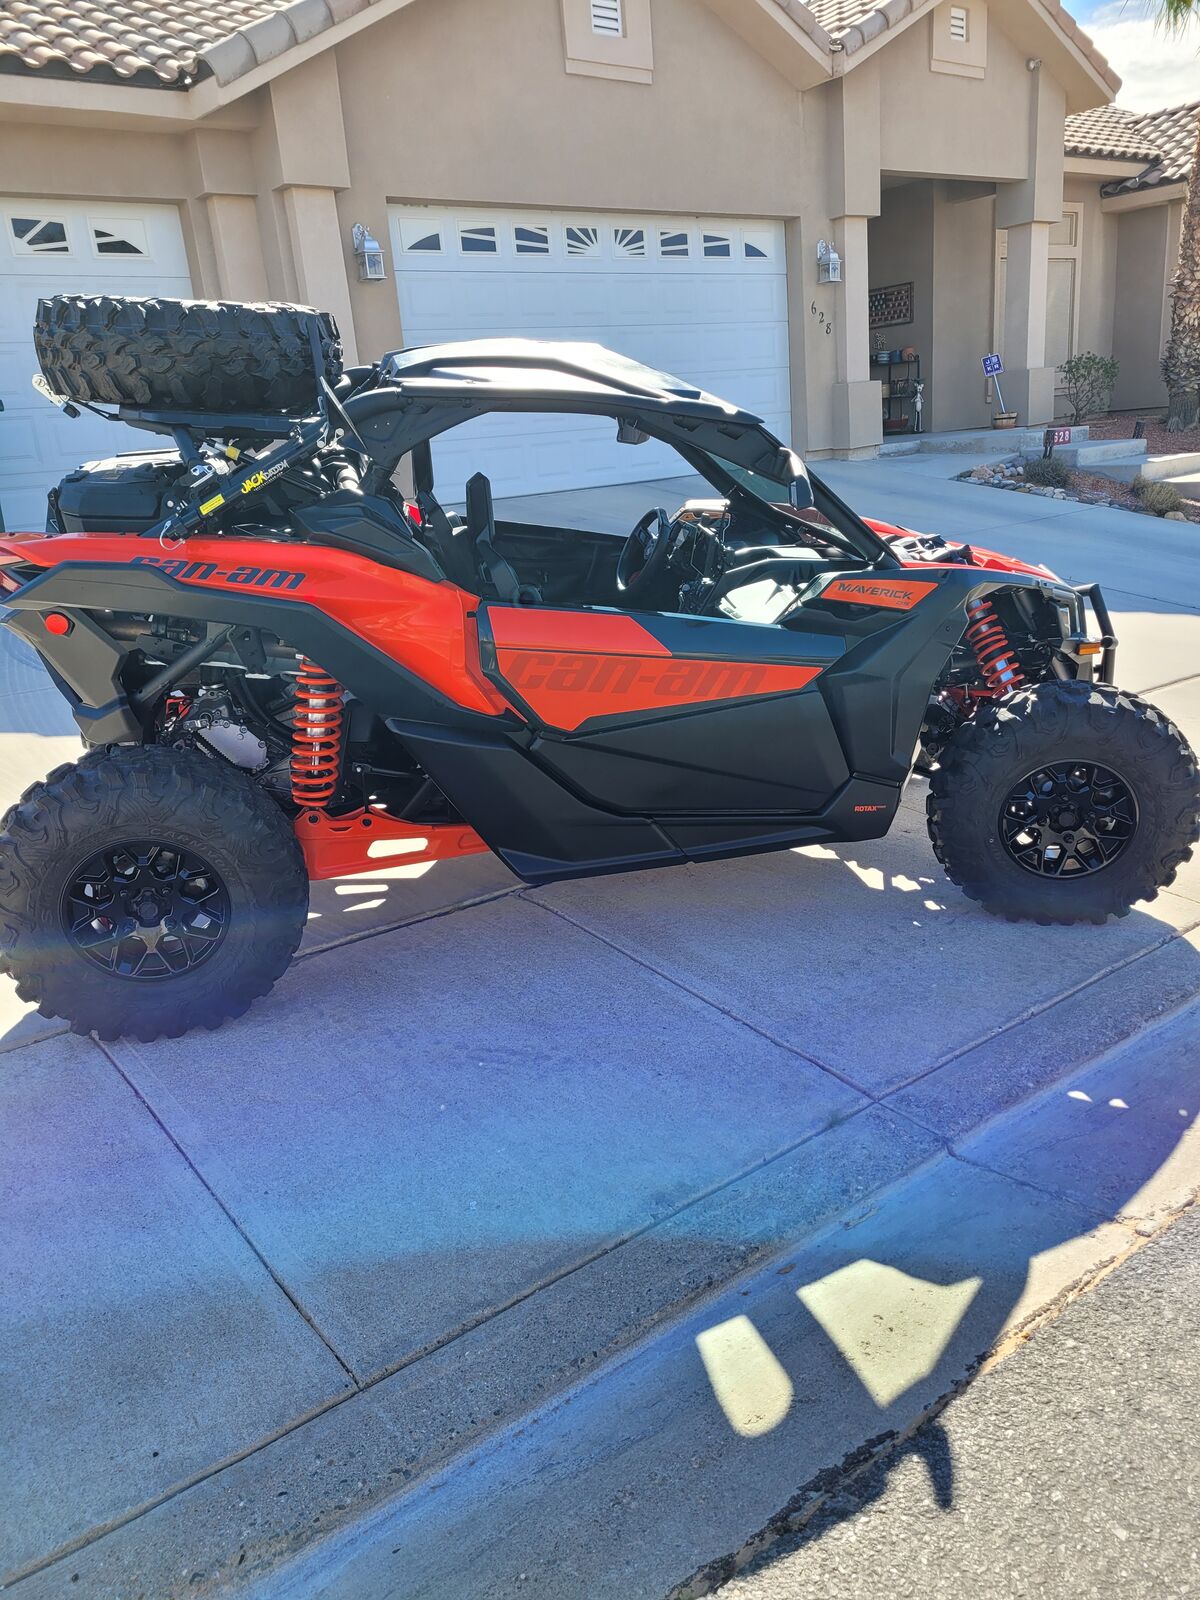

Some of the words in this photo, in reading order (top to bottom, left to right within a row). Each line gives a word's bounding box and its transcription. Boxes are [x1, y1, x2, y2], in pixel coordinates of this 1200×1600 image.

[811, 300, 832, 335] 628
[1054, 430, 1070, 443] 628
[838, 582, 914, 600] MAVERICK
[506, 653, 768, 698] can-am
